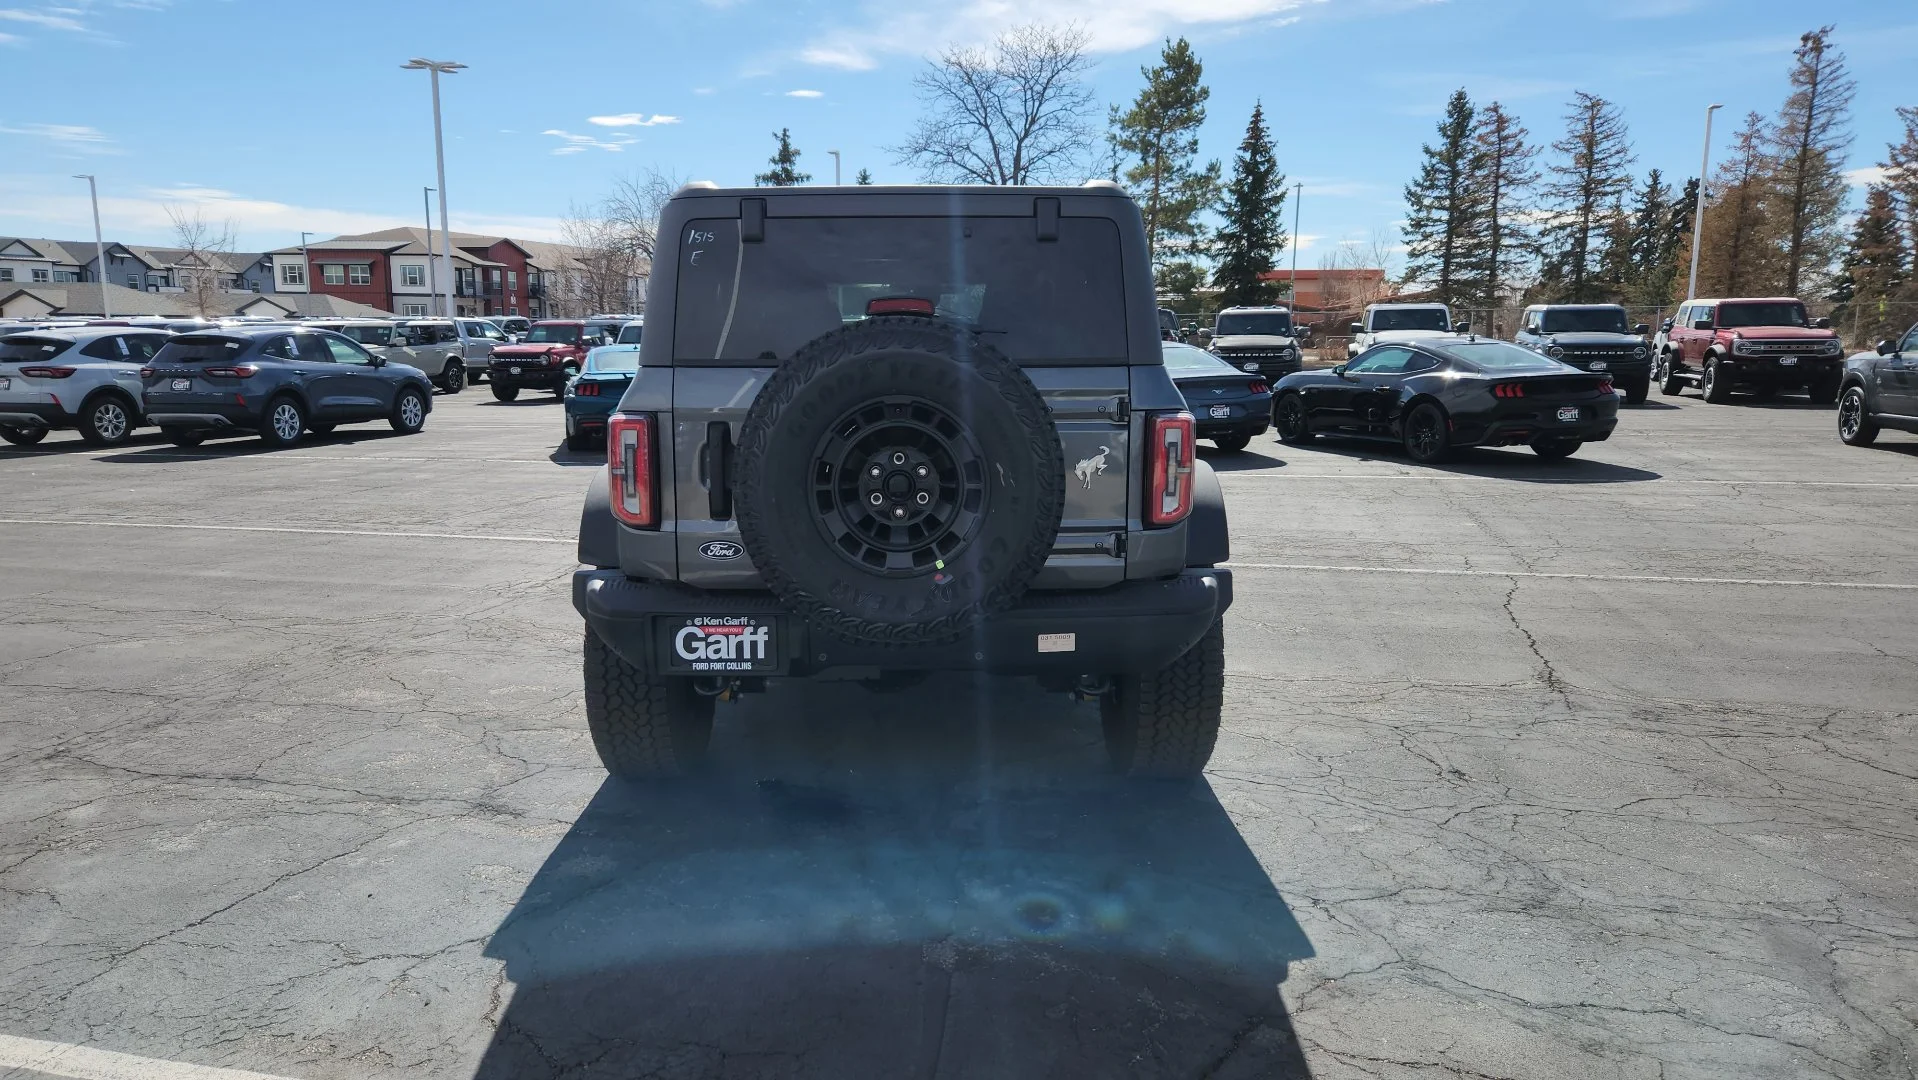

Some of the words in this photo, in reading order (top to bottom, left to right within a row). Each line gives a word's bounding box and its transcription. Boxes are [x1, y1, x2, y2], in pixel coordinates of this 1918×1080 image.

[172, 381, 190, 389] Garff
[1210, 407, 1230, 416] Garff
[1557, 409, 1579, 419] Garff
[707, 544, 735, 556] Ford
[703, 616, 723, 626] Ken
[723, 616, 748, 626] Garff
[675, 626, 769, 660] Garff
[692, 662, 710, 670] FORD
[710, 662, 726, 670] FORT
[726, 662, 752, 670] COLLINS
